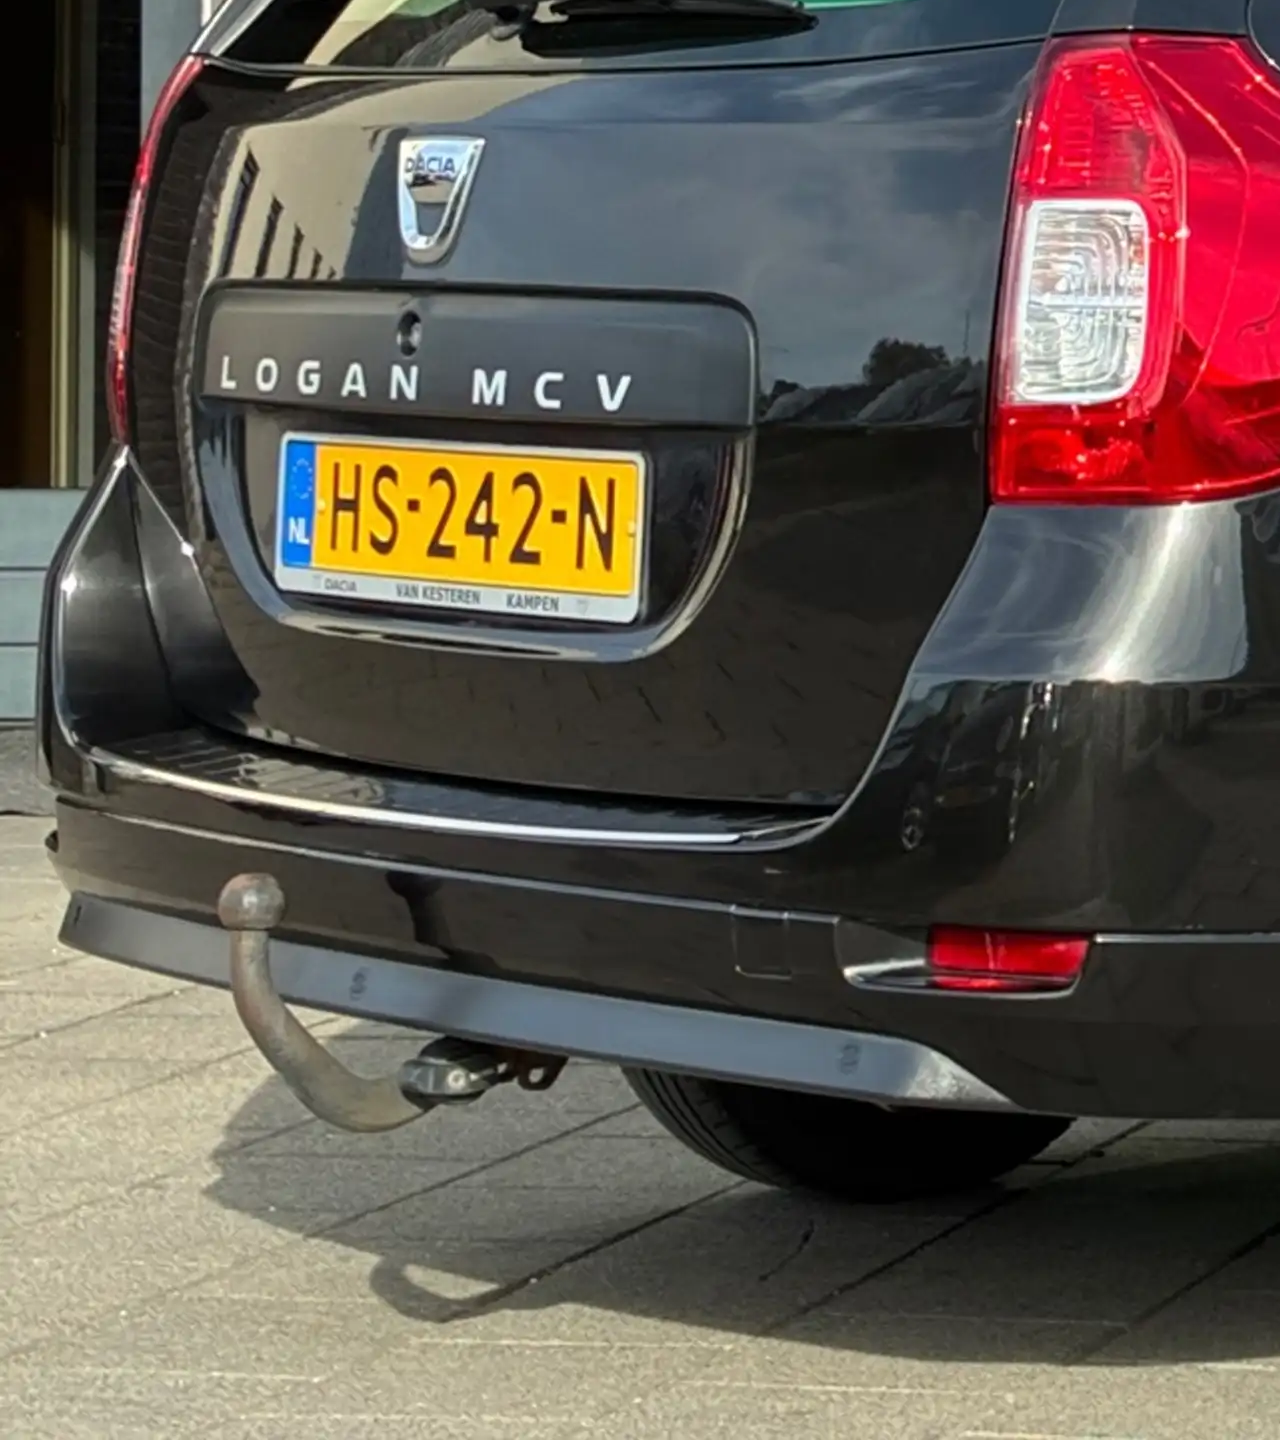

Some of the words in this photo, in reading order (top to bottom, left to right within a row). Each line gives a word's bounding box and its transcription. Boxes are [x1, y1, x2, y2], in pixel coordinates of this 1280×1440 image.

[404, 153, 455, 172] DACIA
[220, 355, 418, 402] LOGAN
[472, 368, 631, 412] MCV
[288, 516, 310, 545] NL
[330, 461, 616, 572] HS-242-N
[323, 577, 358, 593] DACIA
[396, 582, 420, 599] VAN
[421, 585, 482, 605] KESTEREN
[505, 592, 560, 613] KAMPEN
